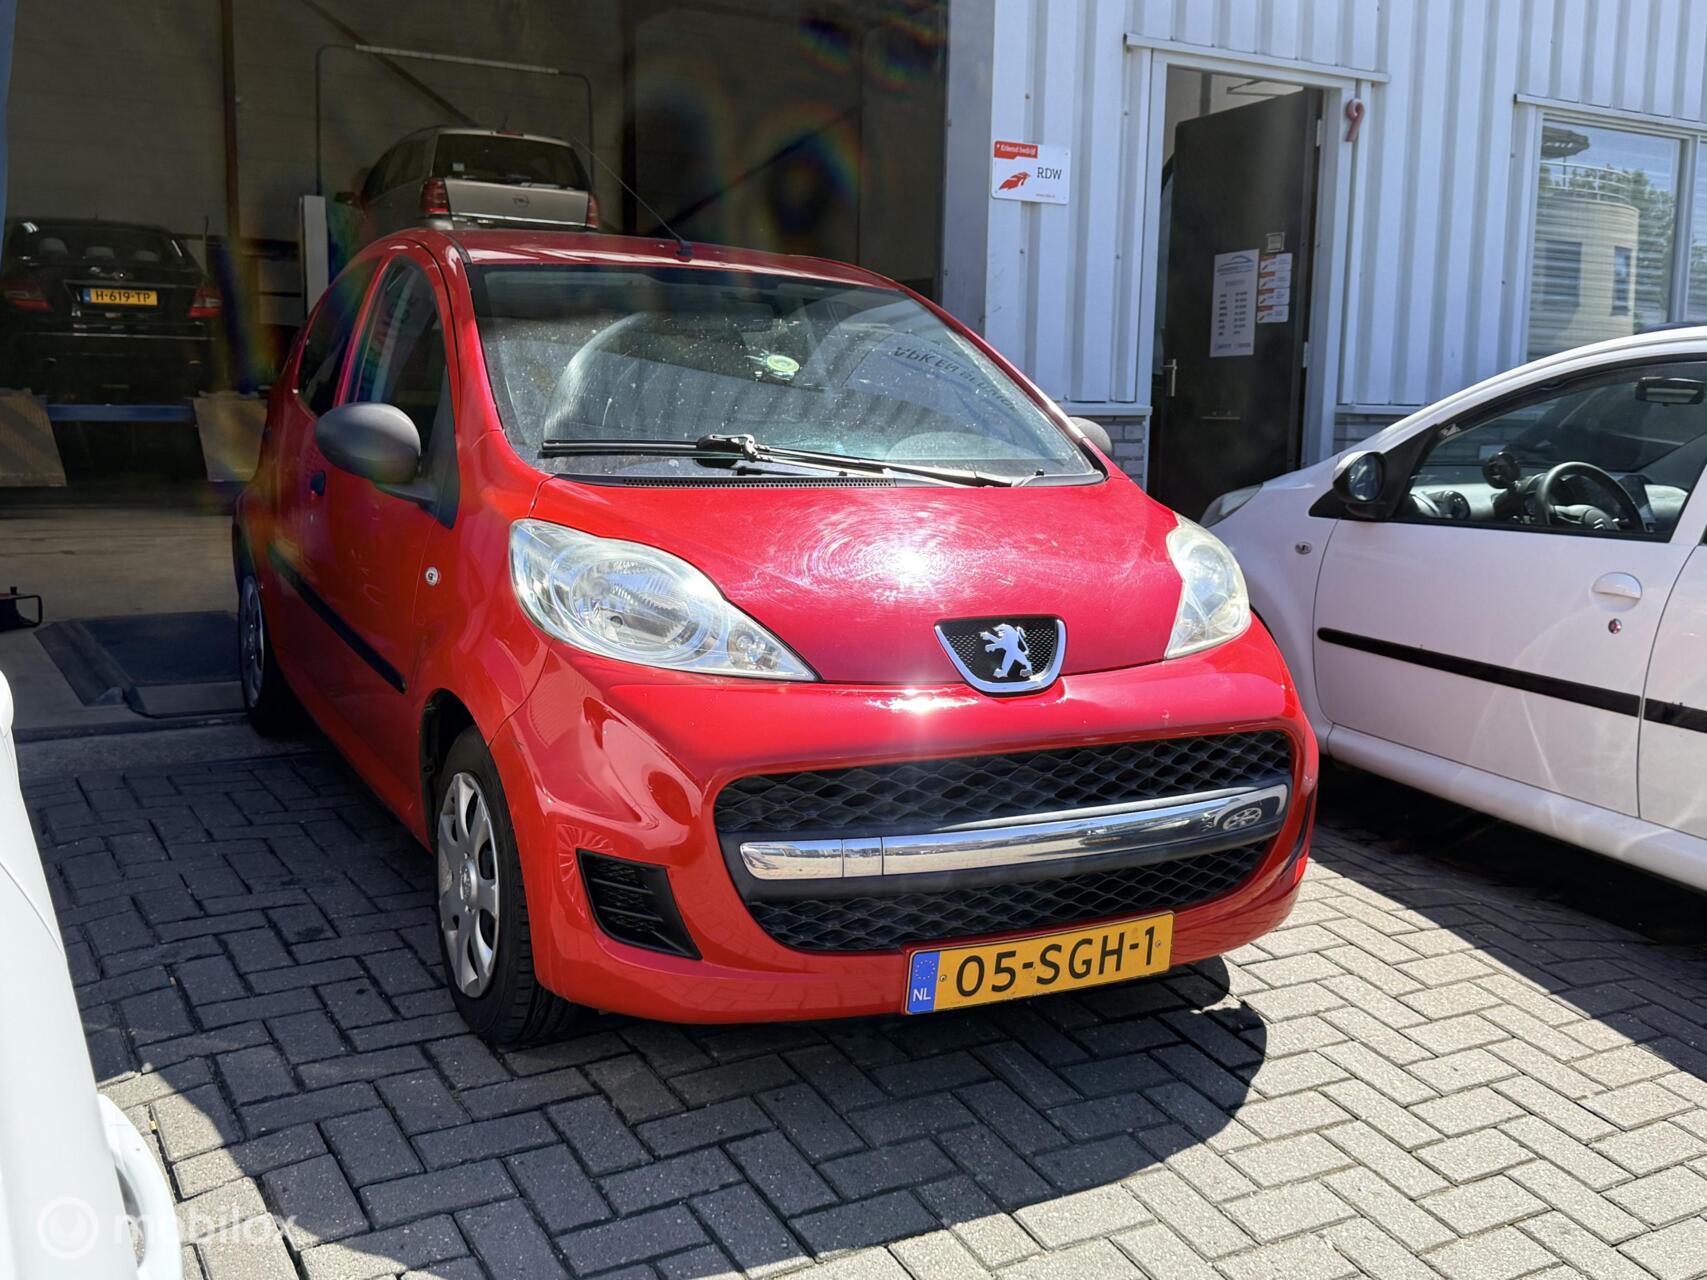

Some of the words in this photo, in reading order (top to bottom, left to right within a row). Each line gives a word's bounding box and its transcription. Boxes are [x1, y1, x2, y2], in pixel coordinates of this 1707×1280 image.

[1345, 99, 1364, 142] 9
[1037, 167, 1062, 180] RDW
[95, 290, 151, 303] H-619-TP
[956, 926, 1156, 997] 05-SGH-1
[912, 988, 932, 1002] NL
